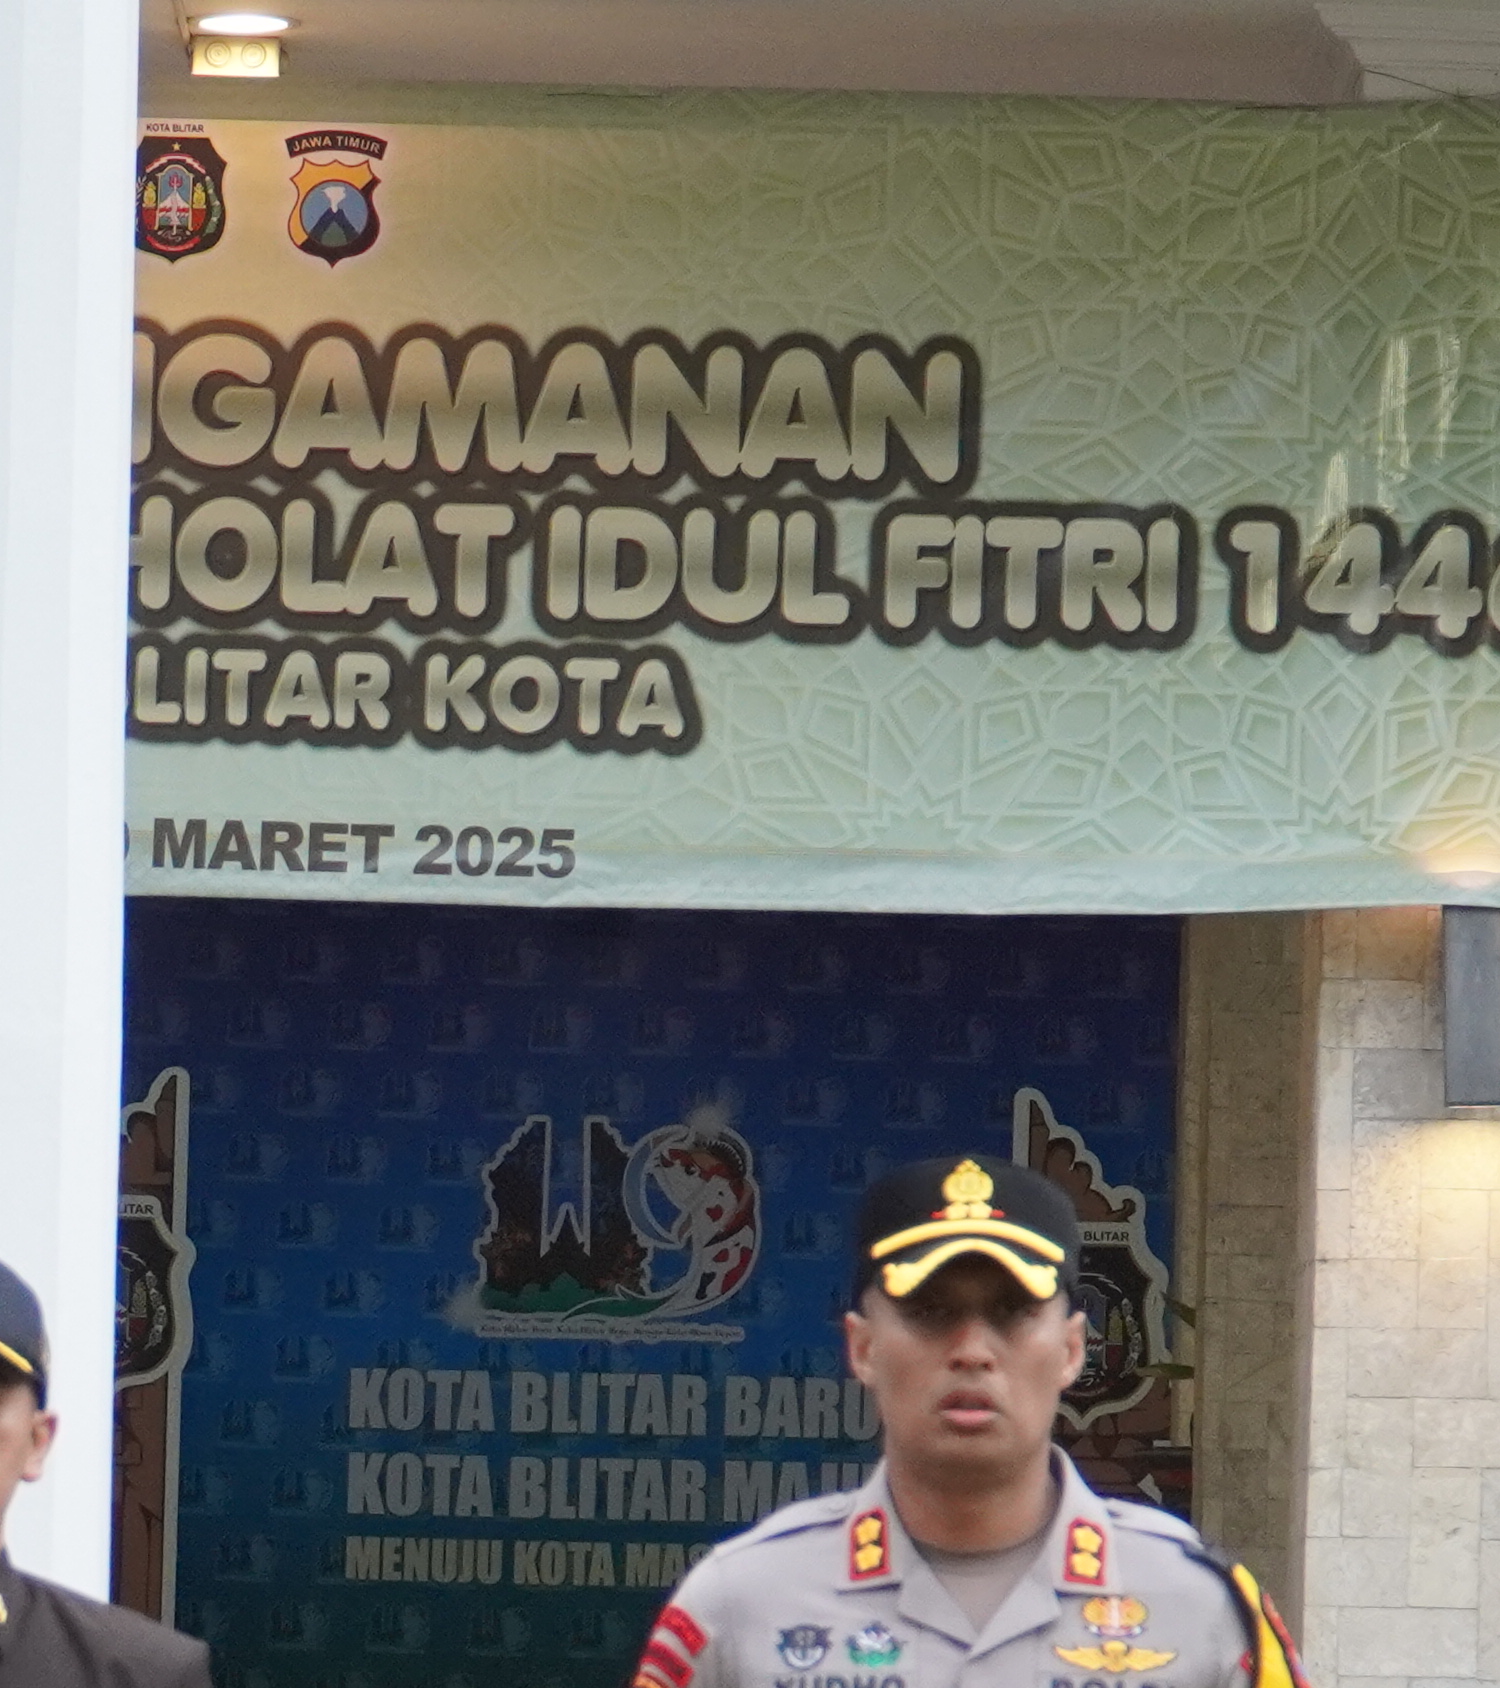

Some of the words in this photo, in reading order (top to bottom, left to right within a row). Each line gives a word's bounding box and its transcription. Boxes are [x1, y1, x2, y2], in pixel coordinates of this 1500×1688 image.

[146, 123, 170, 132] KOTA
[172, 124, 204, 133] BLITAR
[292, 135, 333, 153] JAWA
[335, 136, 381, 153] TIMUR
[547, 503, 851, 625] IDUL
[882, 511, 1180, 632] FITRI
[132, 645, 392, 731] LITAR
[424, 652, 686, 738] KOTA
[151, 817, 395, 874] MARET
[412, 825, 576, 878] 2025
[1083, 1230, 1130, 1242] BLITAR
[347, 1367, 495, 1431] KOTA
[509, 1371, 708, 1436] BLITAR
[723, 1375, 881, 1440] BARU
[346, 1451, 494, 1518] KOTA
[508, 1456, 707, 1521] BLITAR
[344, 1535, 501, 1583] MENUJU
[513, 1541, 612, 1585] KOTA
